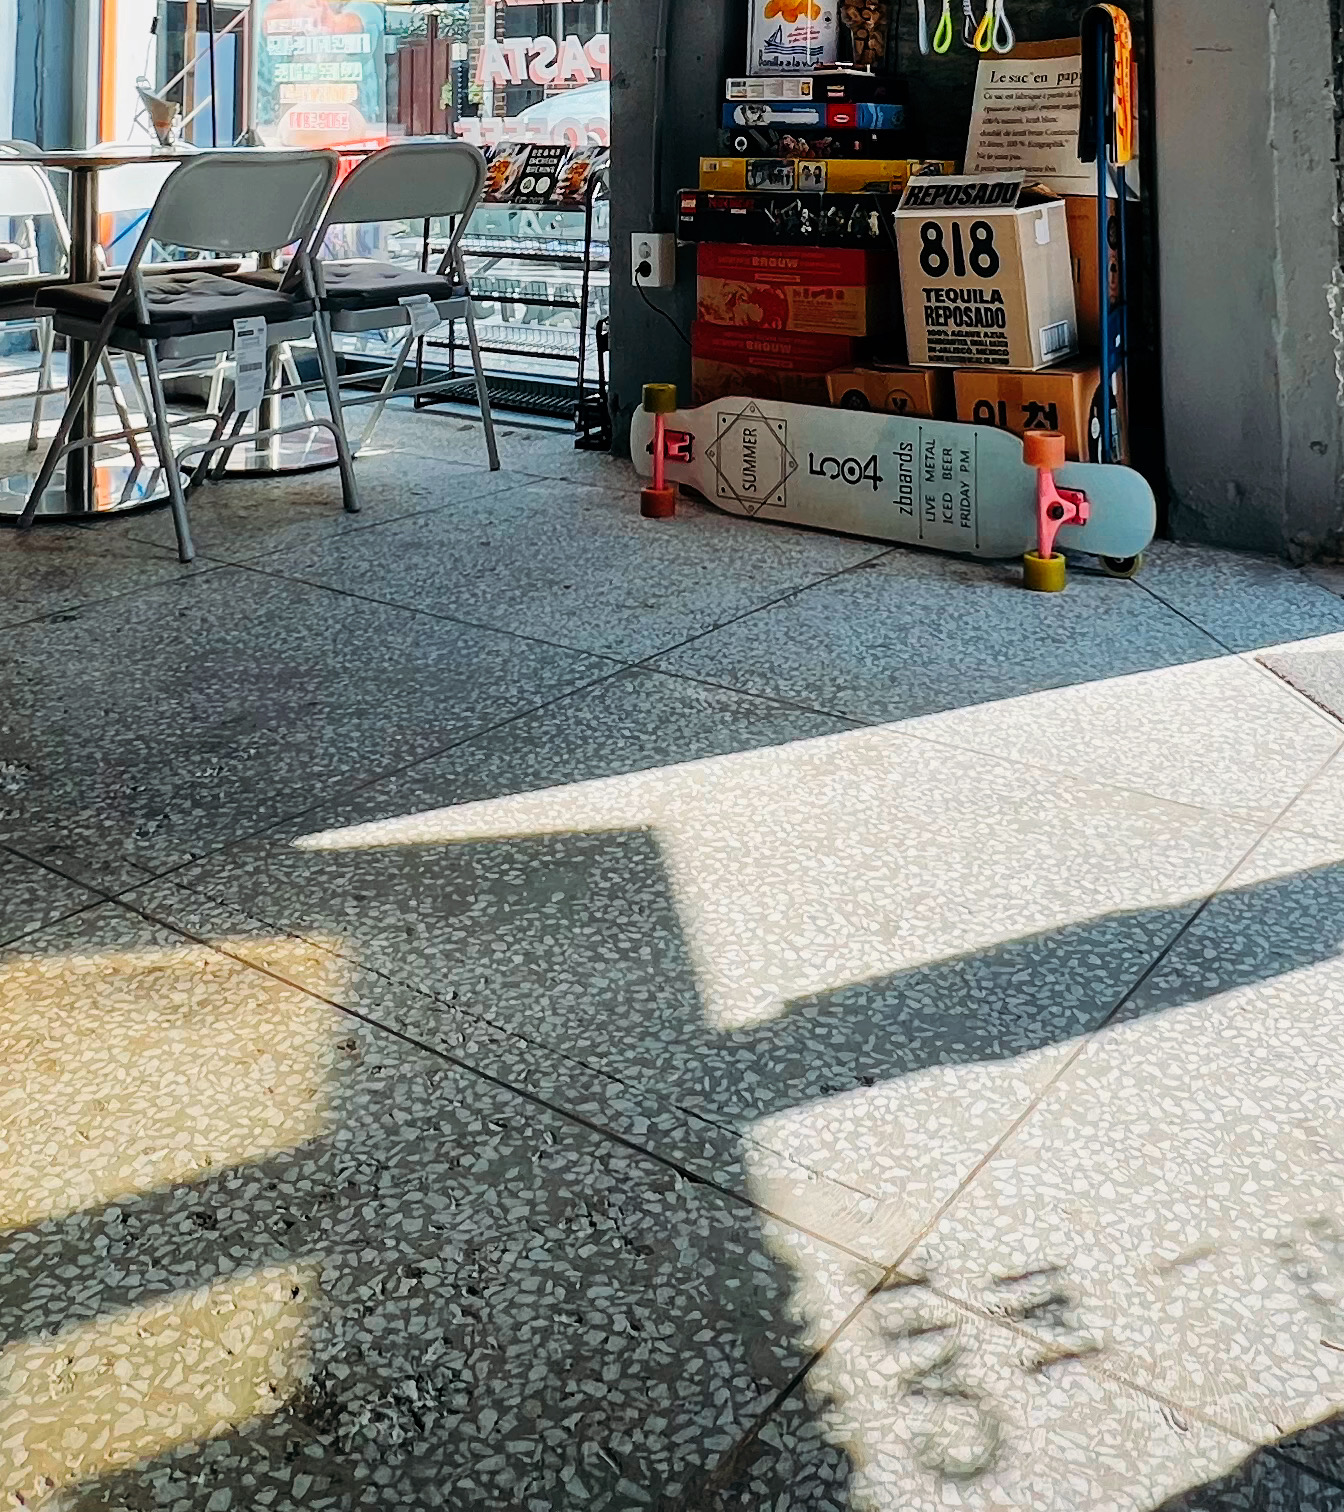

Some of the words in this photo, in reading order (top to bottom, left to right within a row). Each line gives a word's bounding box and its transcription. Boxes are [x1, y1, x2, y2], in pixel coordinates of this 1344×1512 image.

[990, 71, 1006, 83] Le
[1056, 70, 1082, 85] pap
[905, 182, 1021, 206] REPOSADO
[919, 220, 1000, 278] 818
[922, 288, 1004, 305] TEQUILA
[924, 305, 1006, 328] REPOSADO
[742, 427, 758, 493] SUMMER
[924, 439, 936, 482] METAL
[942, 448, 953, 480] BEER
[893, 441, 913, 517] zboards
[924, 494, 936, 522] LIVE
[942, 492, 954, 524] ICED
[960, 481, 972, 529] FRIDAY
